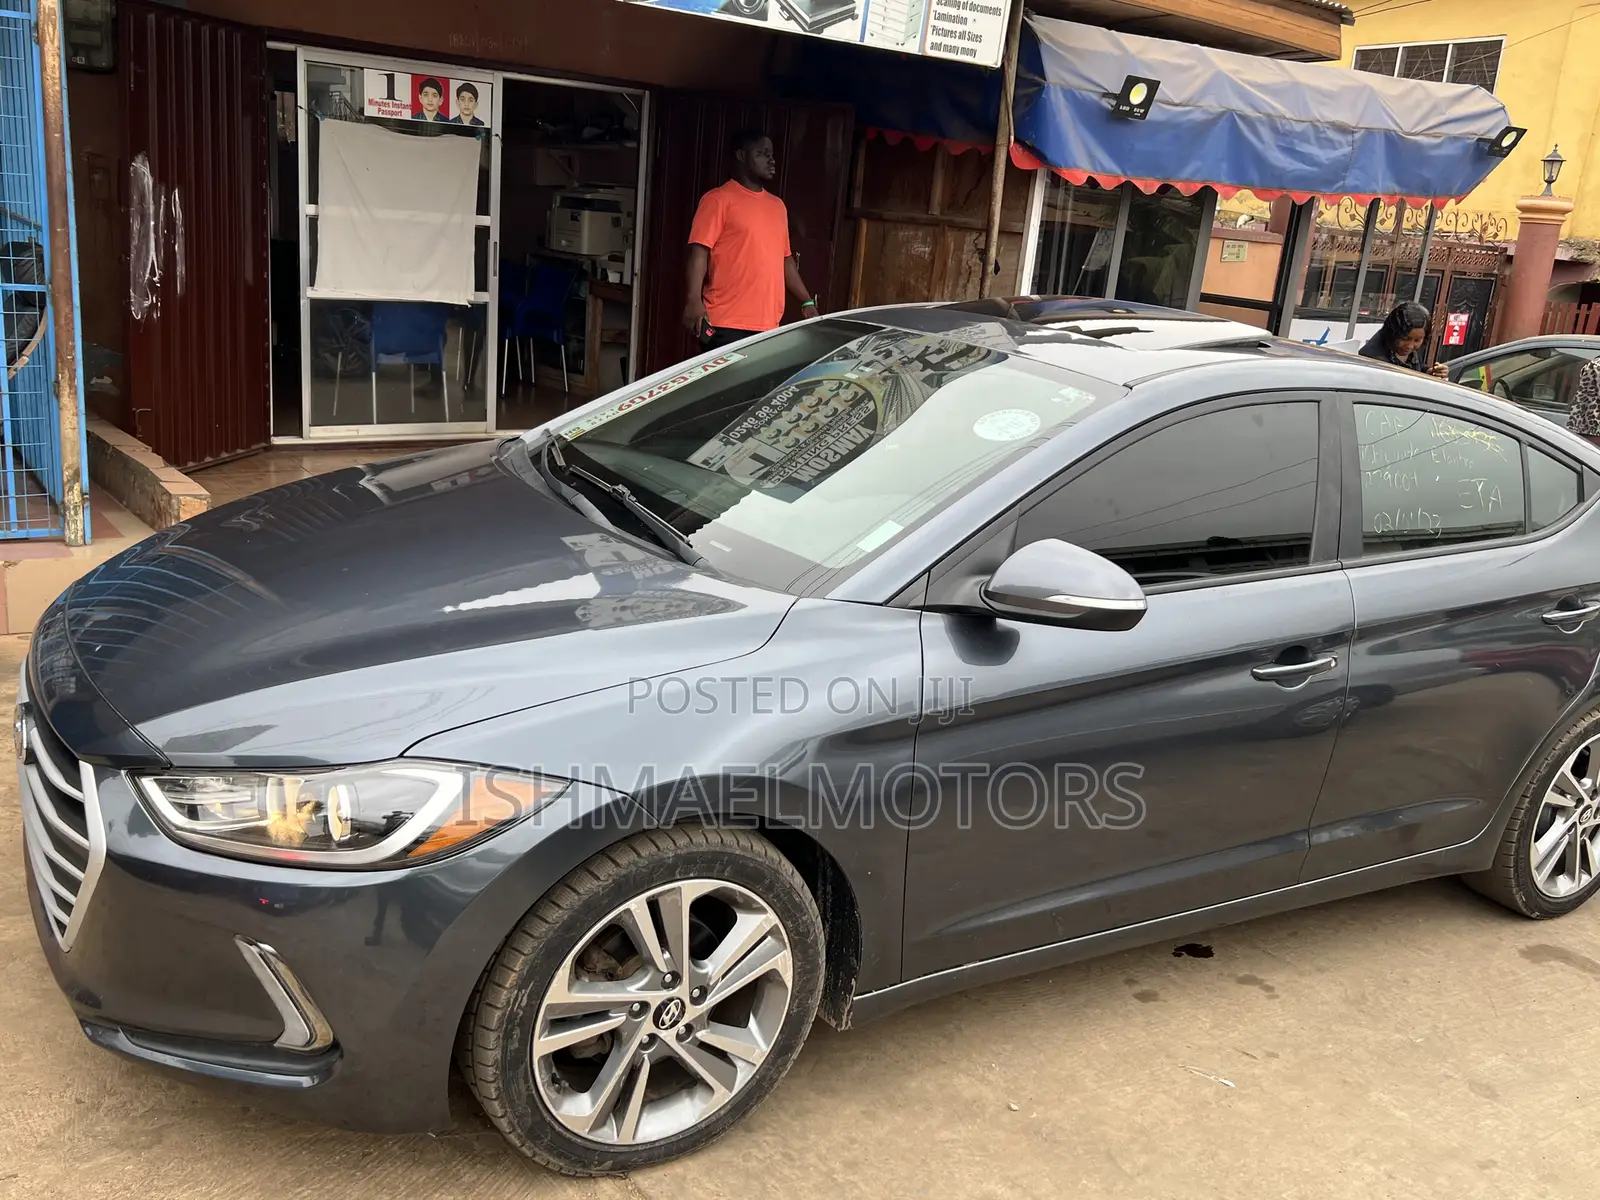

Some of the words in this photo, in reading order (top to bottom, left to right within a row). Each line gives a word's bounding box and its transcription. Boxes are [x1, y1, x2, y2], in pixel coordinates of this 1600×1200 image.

[961, 1, 969, 11] of
[969, 2, 1002, 17] documents
[958, 29, 967, 40] all
[967, 31, 983, 44] Sizes
[930, 41, 942, 51] and
[943, 43, 960, 56] many
[378, 73, 402, 102] 1
[368, 98, 391, 109] Minutes
[391, 101, 412, 111] Instant
[377, 107, 403, 117] Passport
